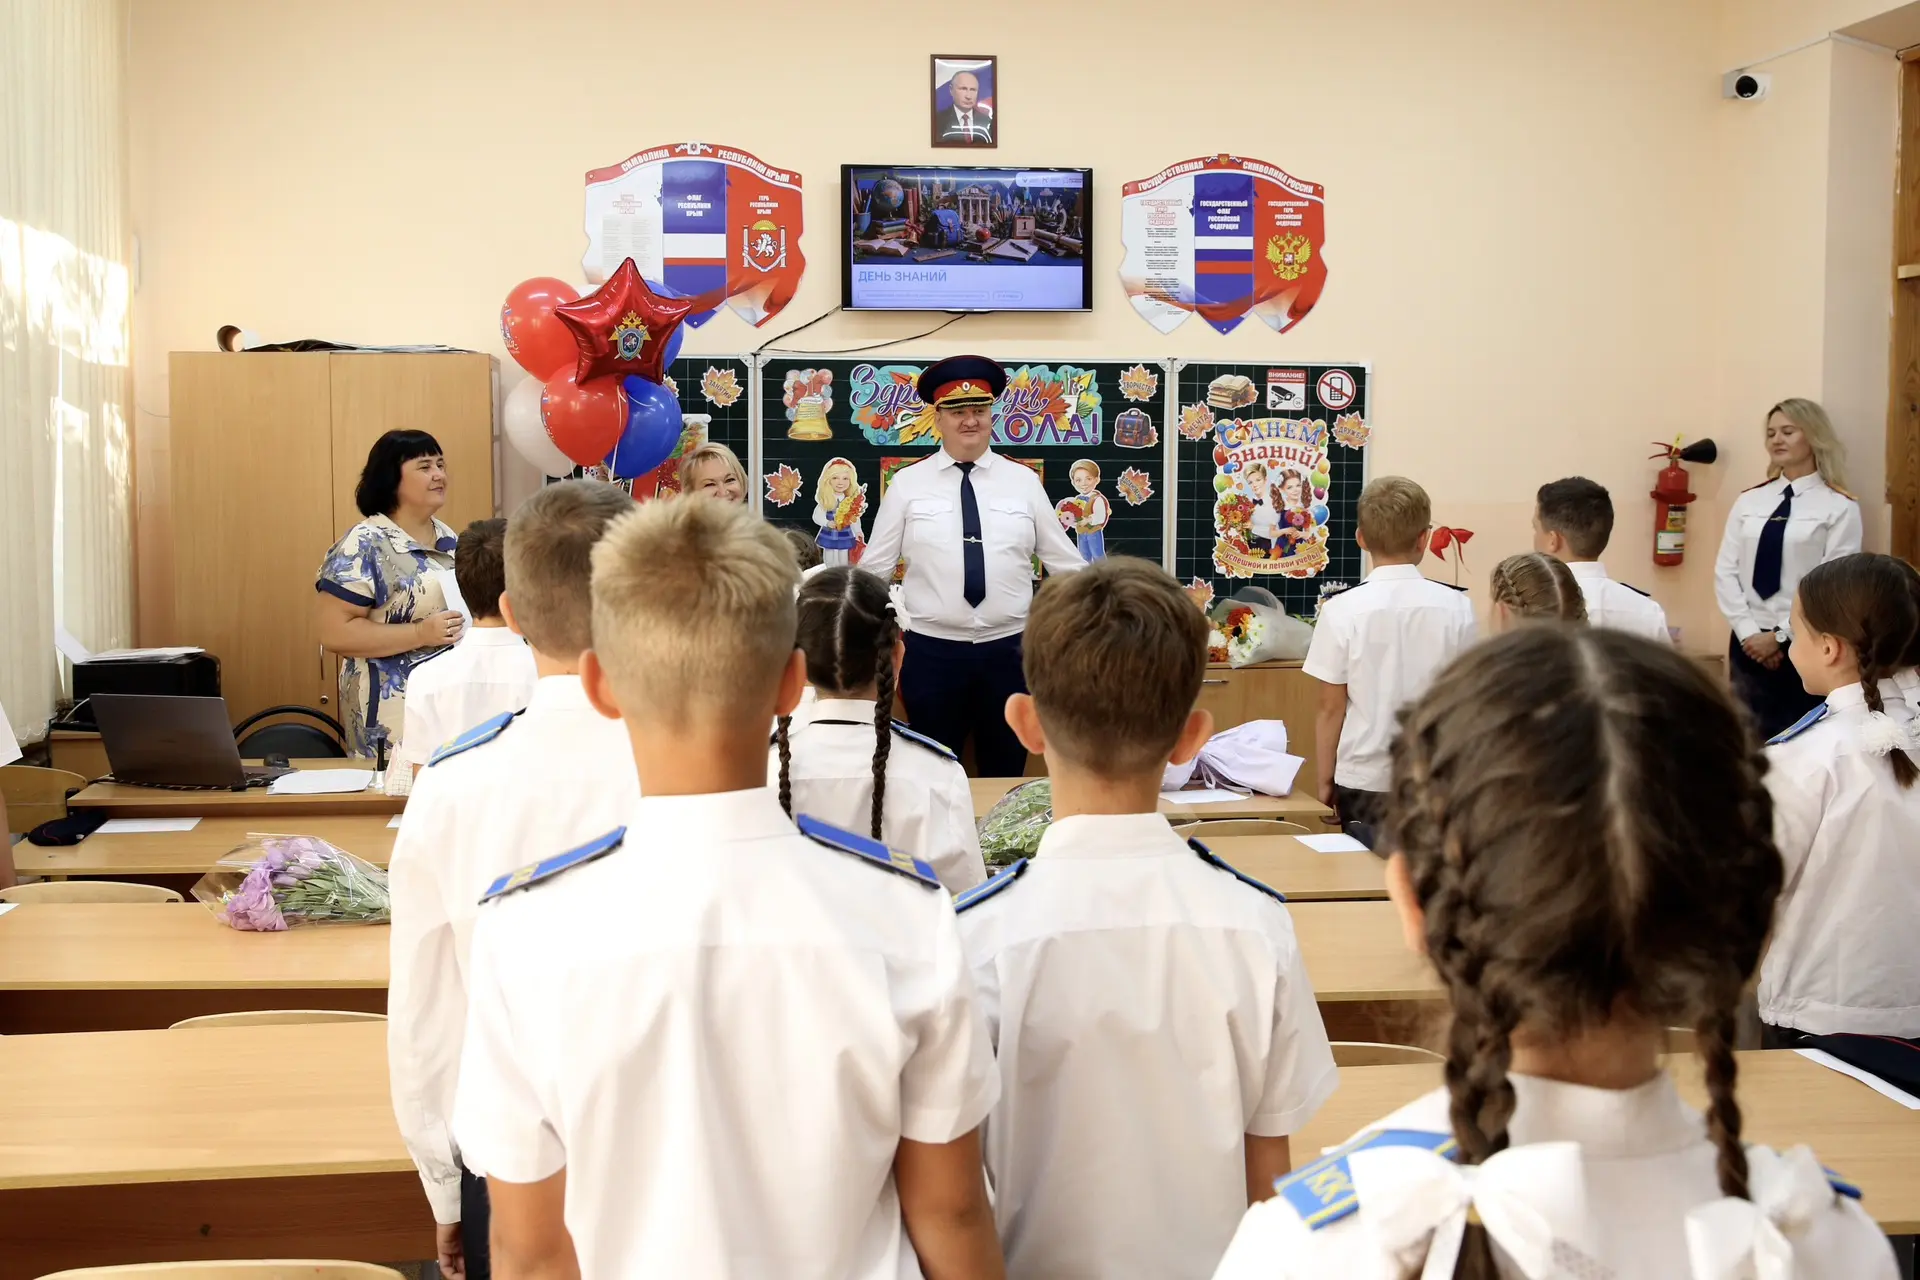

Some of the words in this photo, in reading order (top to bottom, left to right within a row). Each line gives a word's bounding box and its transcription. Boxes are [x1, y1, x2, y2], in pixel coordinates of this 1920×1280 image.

[620, 148, 670, 172] СИМВОЛИКА
[717, 149, 767, 175] РЕСПУБЛИКИ
[765, 166, 791, 183] КРЫМ
[1138, 160, 1204, 192] ГОСУДАРСТВЕННАЯ
[1242, 160, 1288, 186] СИМВОЛИКА
[1285, 175, 1314, 194] РОССИИ
[858, 271, 892, 283] ДЕНЬ
[894, 269, 947, 282] ЗНАНИЙ
[1268, 371, 1305, 379] ВНИМАНИЕ!
[708, 379, 732, 400] ЗАНЯТИЯ
[1122, 380, 1155, 393] ТВОРЧЕСТВО
[991, 412, 1099, 444] КОЛА!
[1187, 413, 1209, 433] МЕЧТА
[1217, 422, 1243, 449] С
[1250, 420, 1322, 447] ДНЕМ
[1338, 426, 1365, 441] ДРУЖБА
